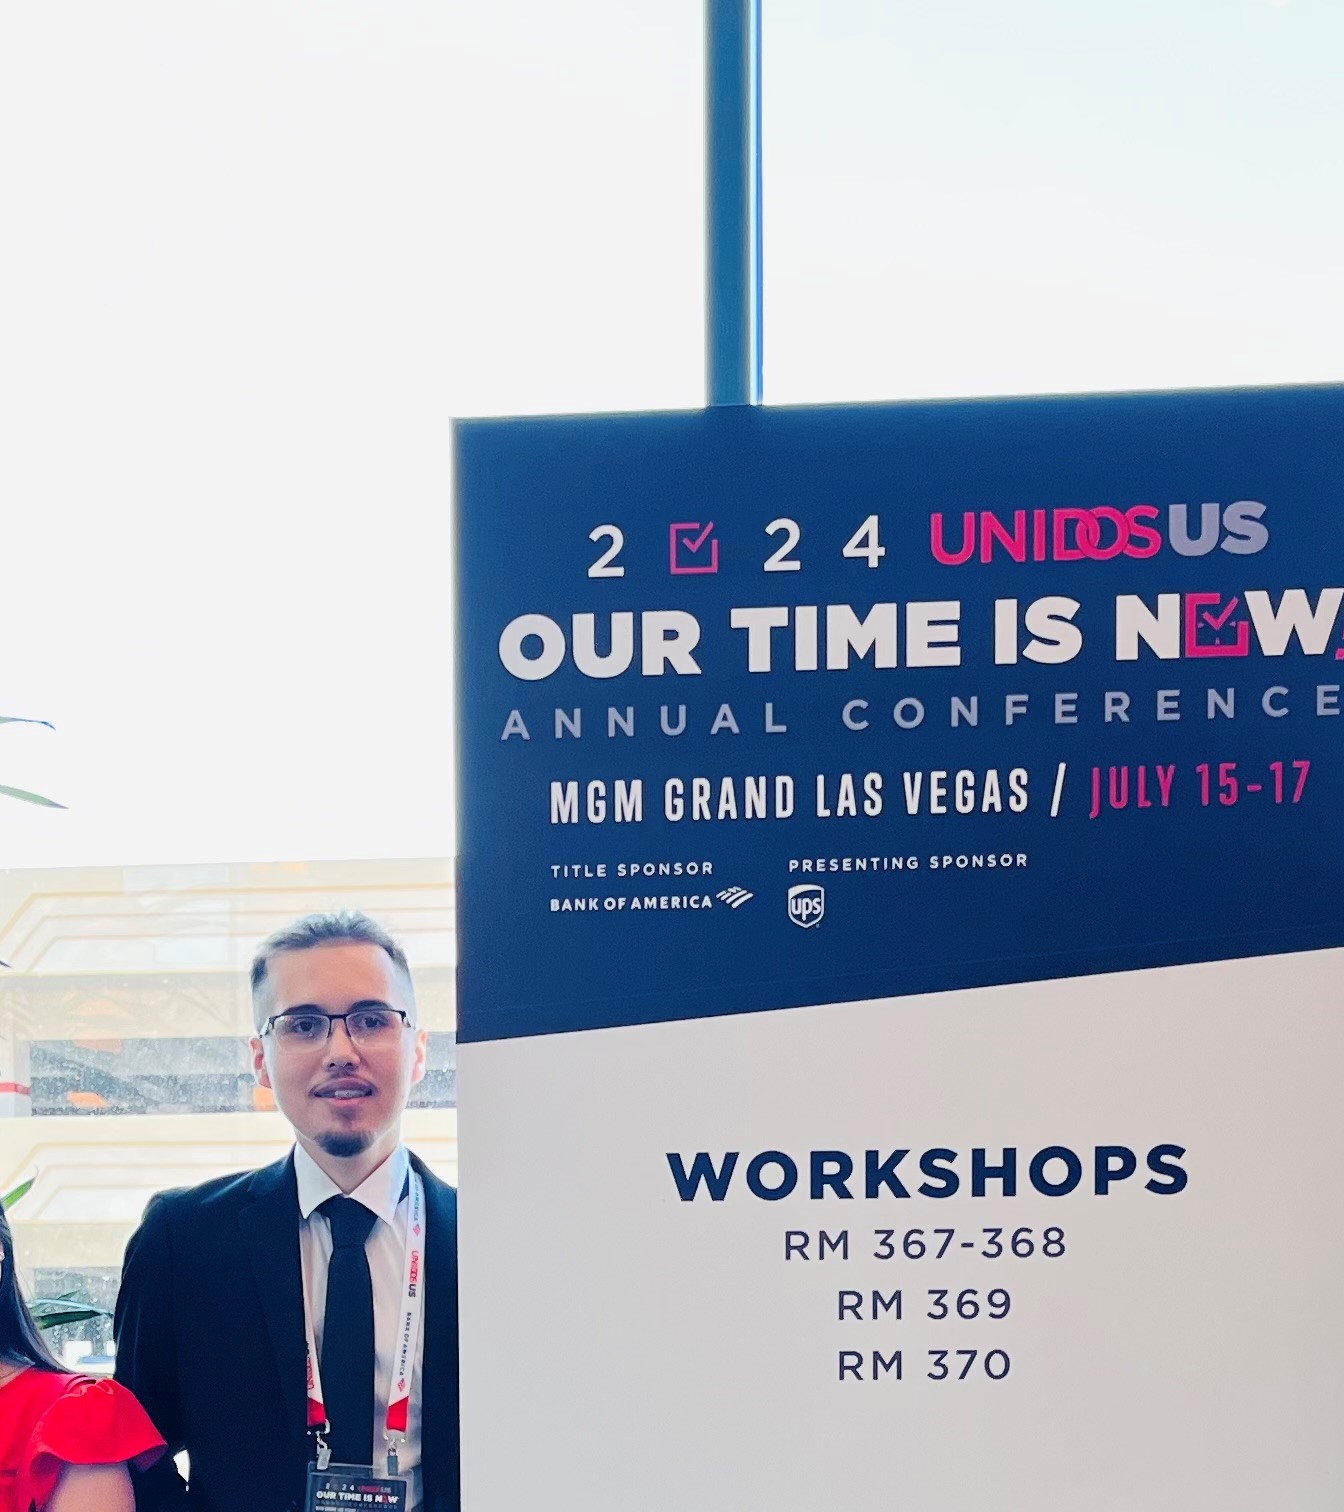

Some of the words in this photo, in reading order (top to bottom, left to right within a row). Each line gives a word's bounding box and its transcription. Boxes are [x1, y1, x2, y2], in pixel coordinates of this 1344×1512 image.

[499, 611, 701, 680] OUR
[731, 601, 960, 672] TIME
[995, 597, 1082, 664] IS
[501, 703, 786, 740] ANNUAL
[842, 685, 1340, 730] CONFERENCE
[551, 780, 642, 823] MGM
[665, 776, 793, 821] GRAND
[817, 772, 882, 817] LAS
[904, 768, 1027, 814] VEGAS
[1089, 765, 1175, 819] JULY
[1196, 760, 1310, 805] 15-17
[551, 864, 606, 878] TITLE
[618, 862, 712, 876] SPONSOR
[789, 857, 918, 872] PRESENTING
[930, 854, 1026, 868] SPONSOR
[551, 898, 598, 911] BANK
[604, 898, 626, 910] OF
[631, 896, 712, 909] AMERICA
[666, 1144, 1187, 1201] WORKSHOPS
[786, 1230, 848, 1260] RM
[874, 1227, 1065, 1259] 367-368
[839, 1290, 905, 1320] RM
[927, 1289, 1010, 1319] 369
[839, 1351, 905, 1380] RM
[927, 1350, 1010, 1380] 370
